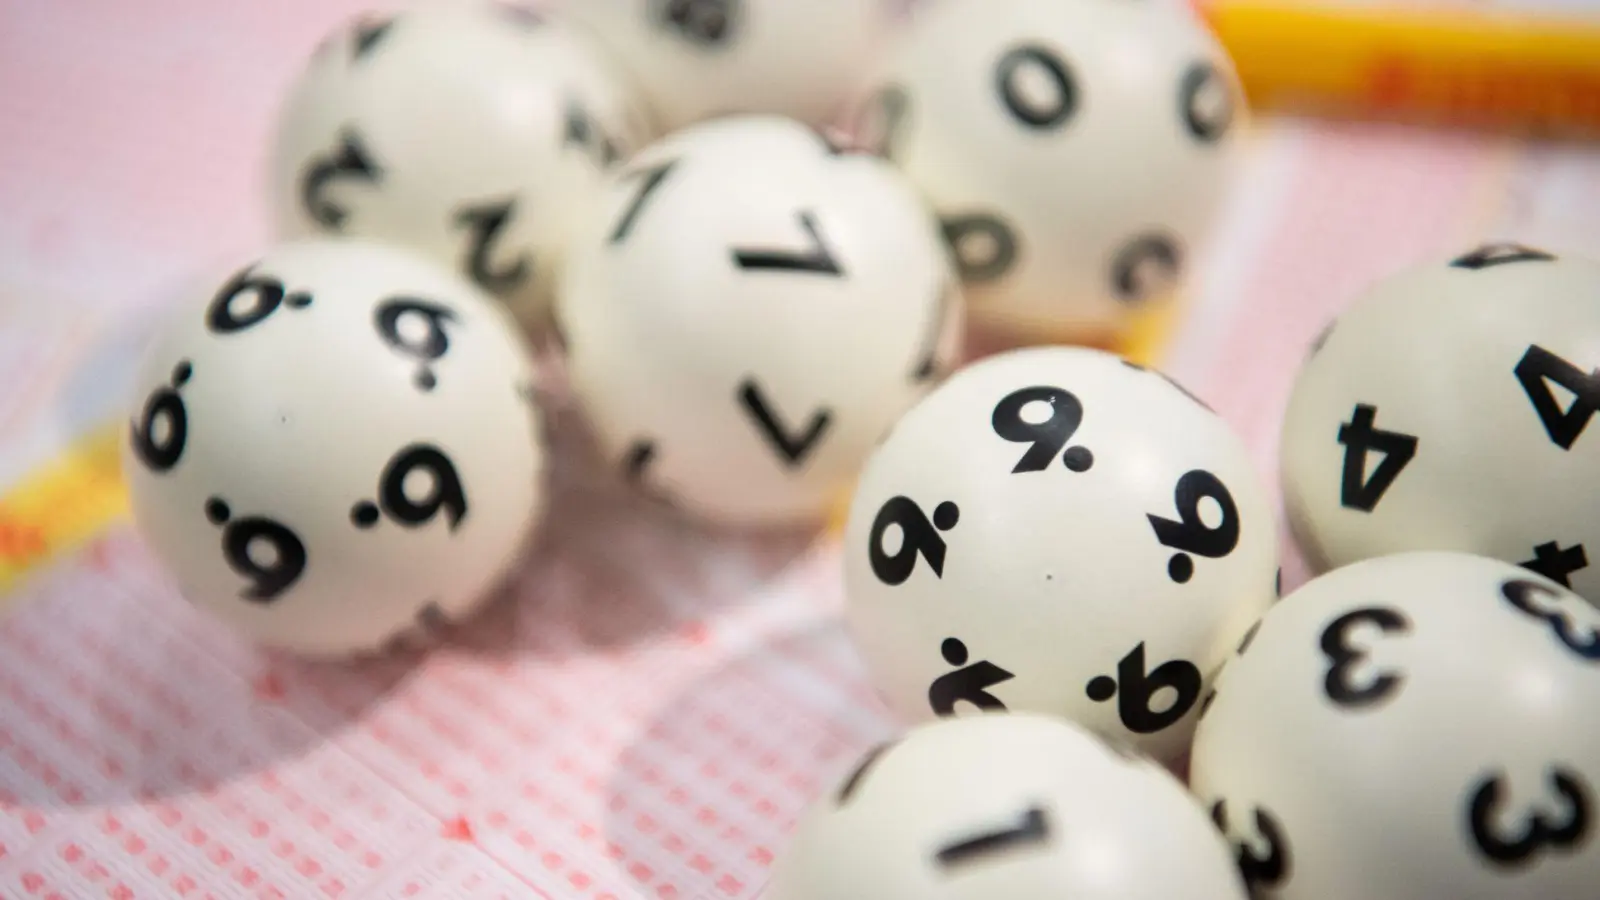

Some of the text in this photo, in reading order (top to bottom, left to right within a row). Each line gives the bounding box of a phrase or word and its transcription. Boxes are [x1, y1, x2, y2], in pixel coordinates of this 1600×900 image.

[995, 45, 1079, 130] 0
[733, 209, 843, 277] 7
[1337, 403, 1419, 513] 4
[1319, 607, 1410, 708] 3
[1470, 768, 1590, 870] 3
